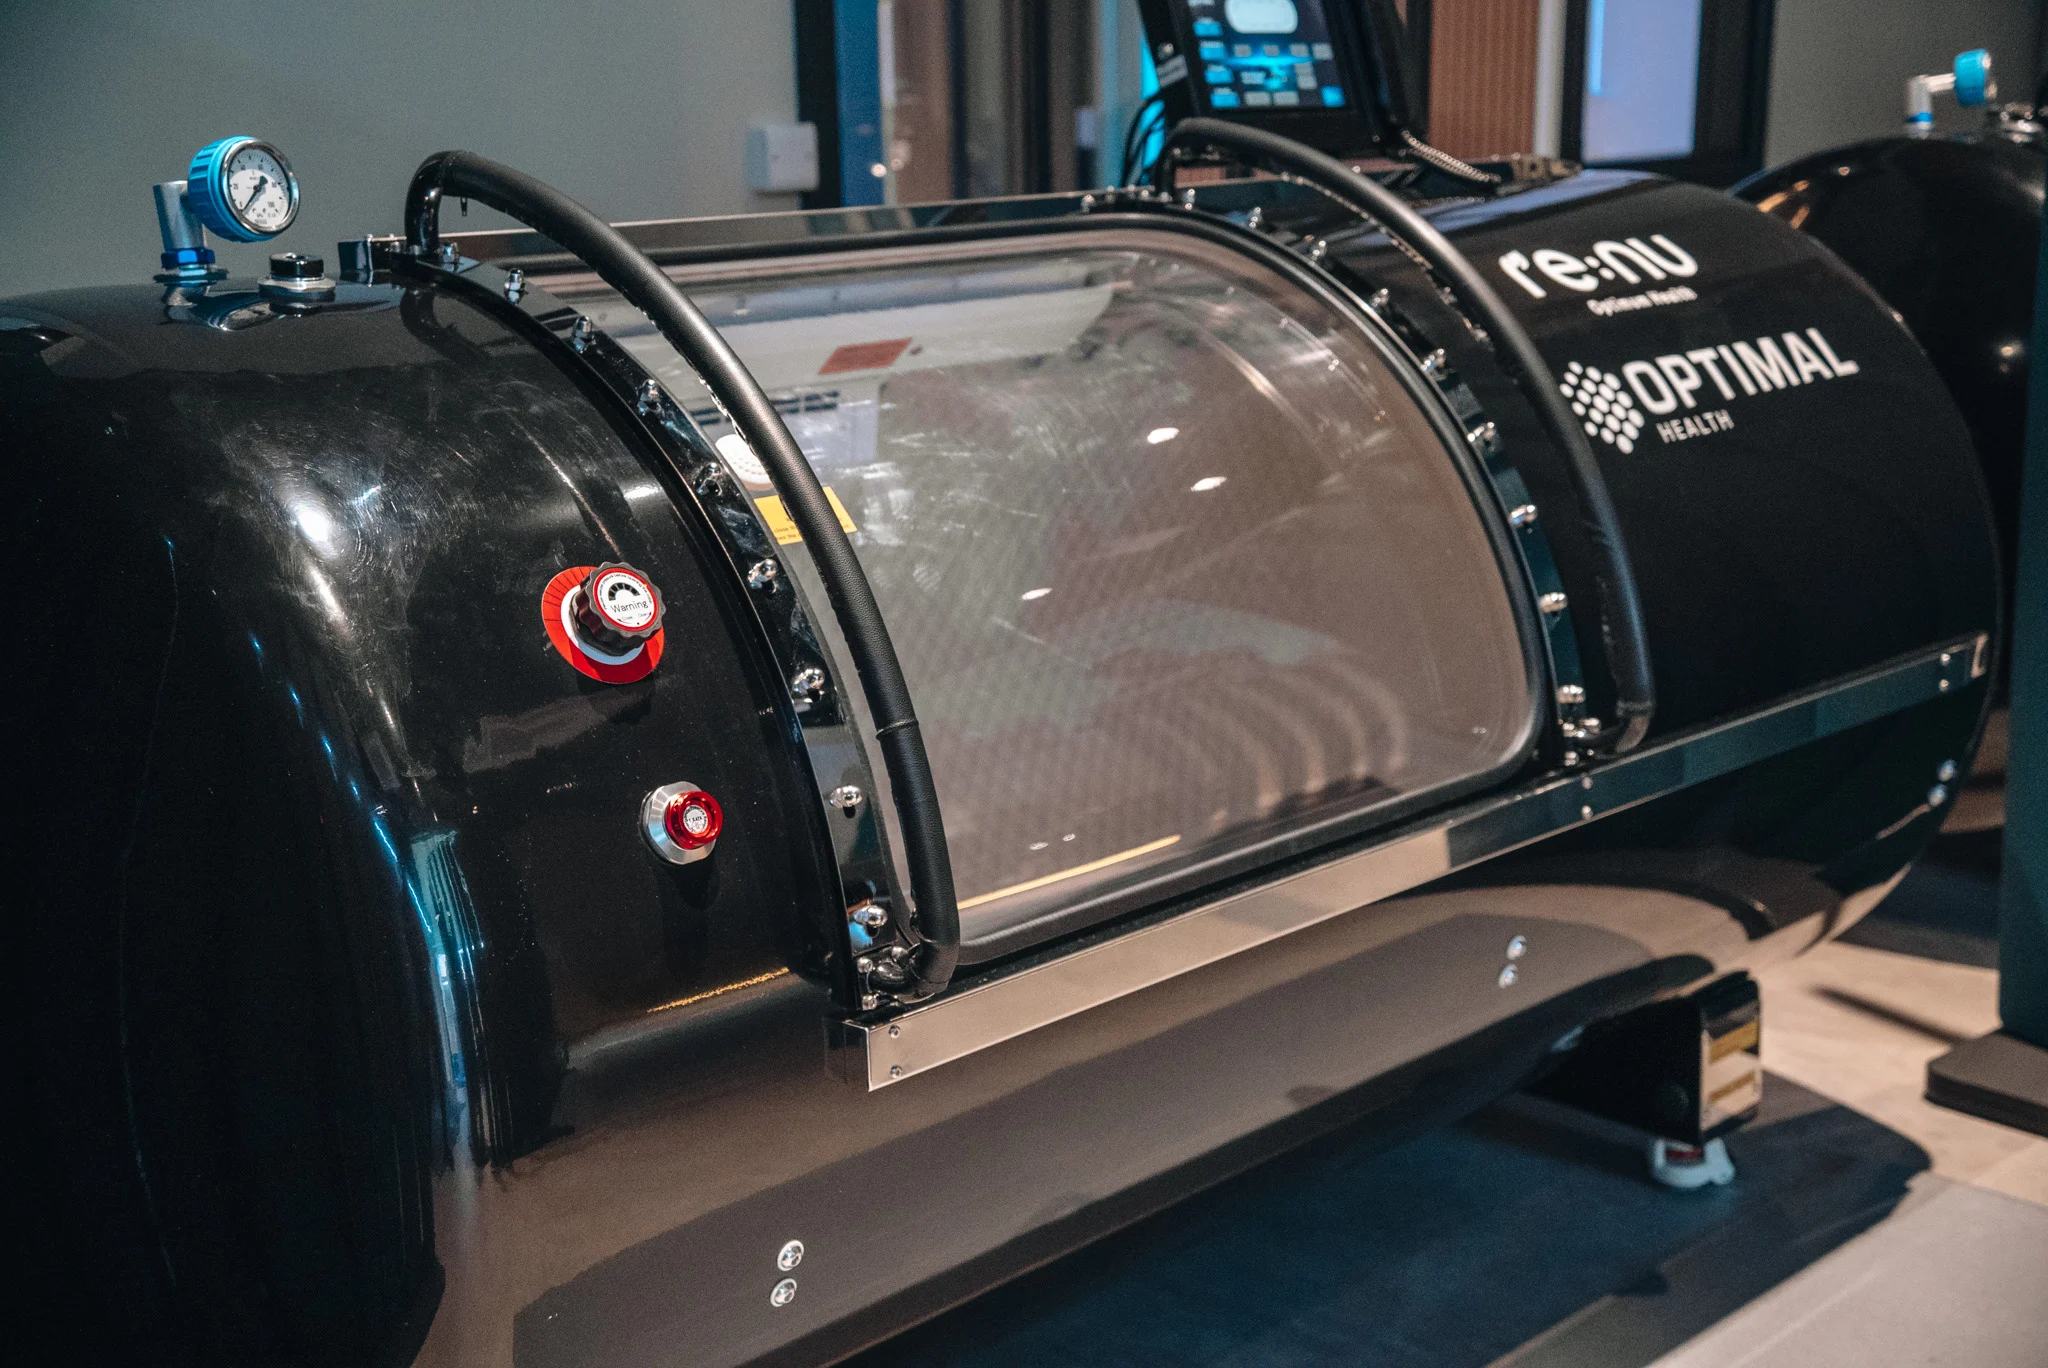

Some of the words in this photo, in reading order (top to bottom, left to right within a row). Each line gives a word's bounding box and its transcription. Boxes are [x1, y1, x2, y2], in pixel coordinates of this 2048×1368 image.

[1498, 234, 1699, 299] re:nu
[1621, 327, 1860, 415] OPTIMAL
[1656, 410, 1735, 443] HEALTH
[610, 600, 649, 613] Warning
